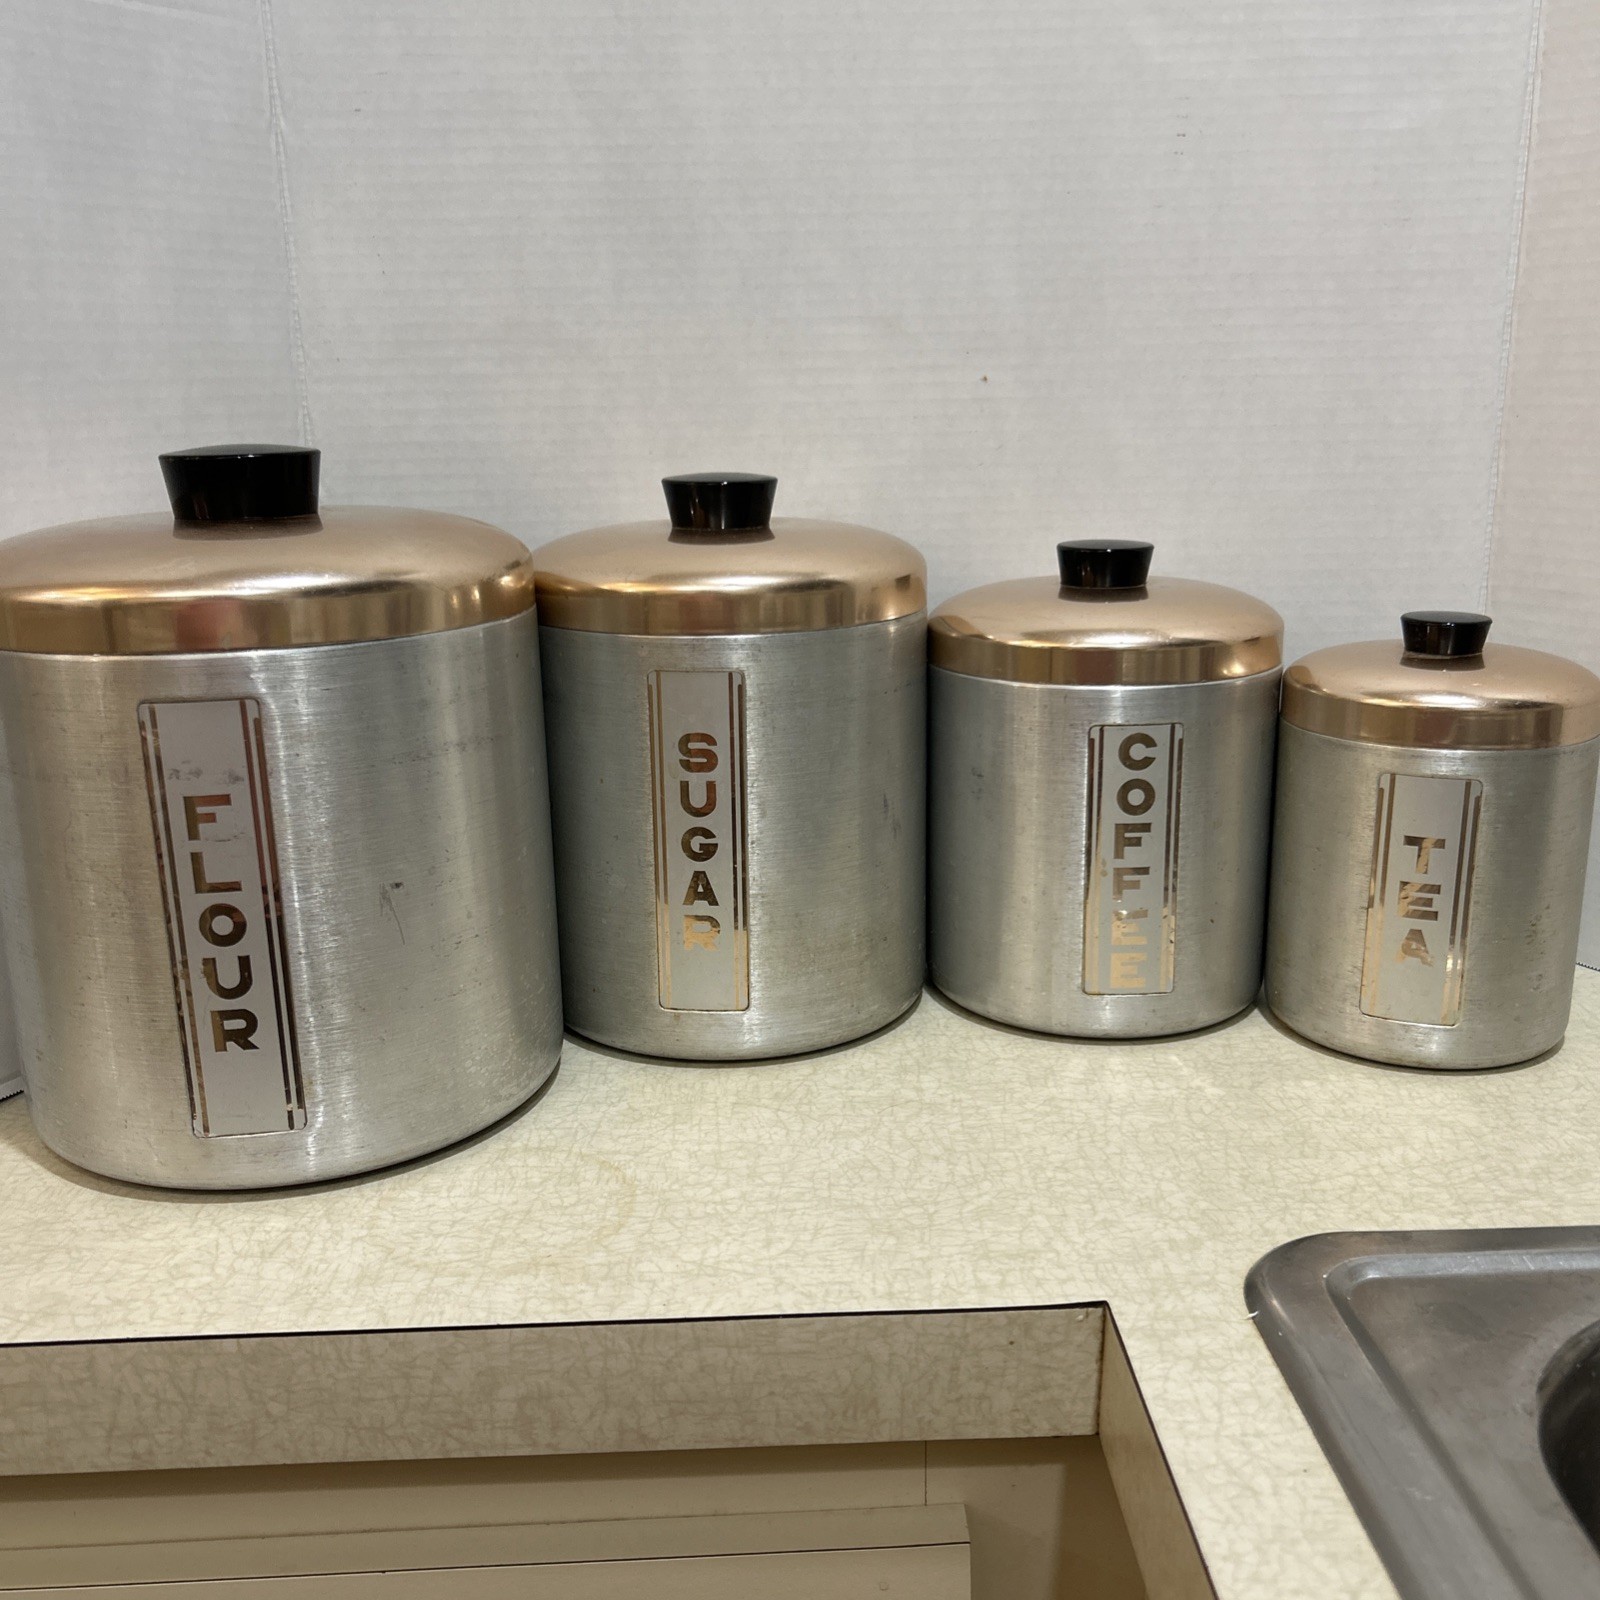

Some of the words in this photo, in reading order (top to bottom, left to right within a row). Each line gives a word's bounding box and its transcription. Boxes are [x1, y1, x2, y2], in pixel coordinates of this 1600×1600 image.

[183, 794, 260, 1052] FLOUR
[678, 732, 721, 951] SUGAR
[1110, 732, 1157, 989] COFFEE
[1396, 835, 1446, 967] TEA
